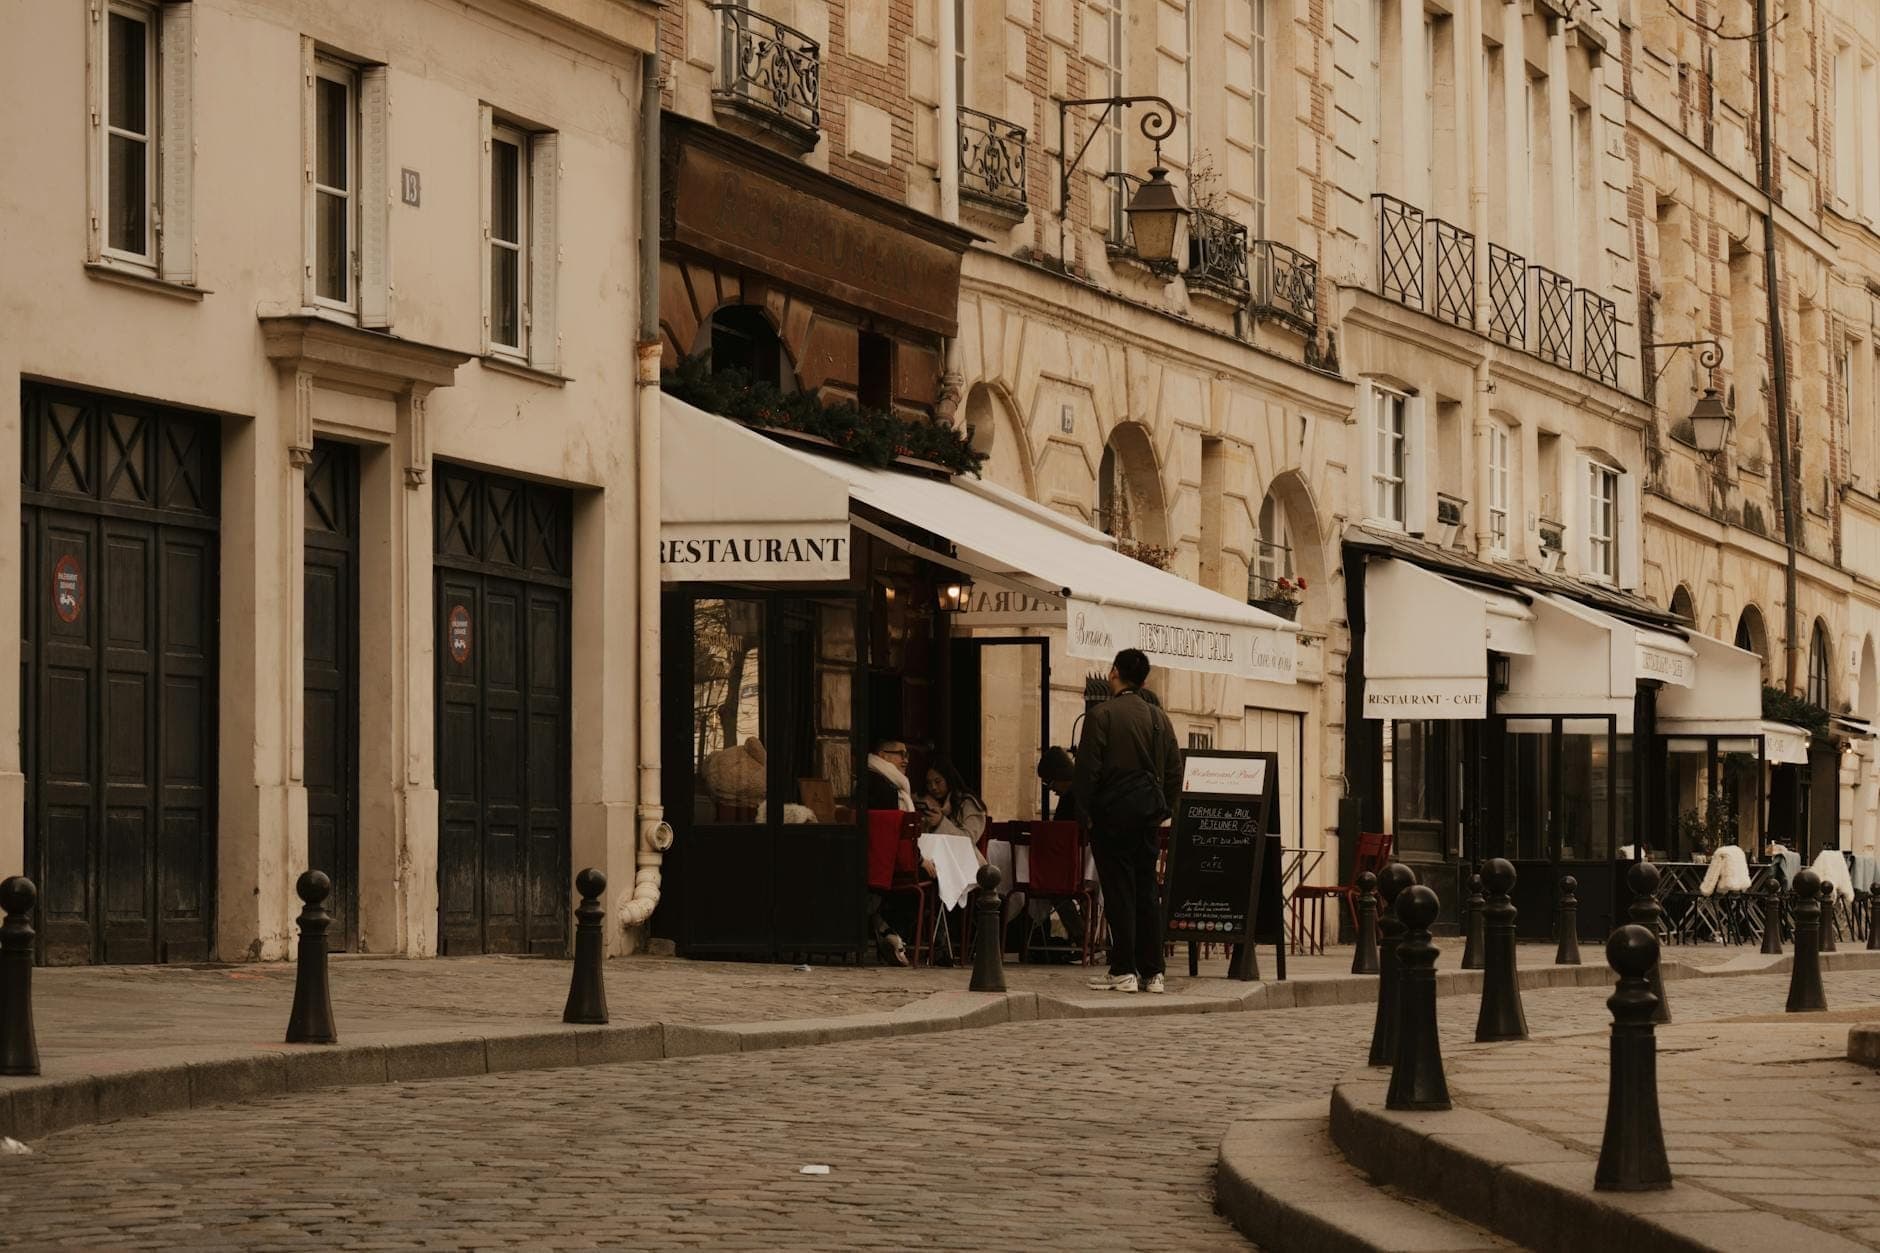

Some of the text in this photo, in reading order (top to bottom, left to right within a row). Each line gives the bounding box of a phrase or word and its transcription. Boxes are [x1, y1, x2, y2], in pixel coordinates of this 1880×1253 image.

[405, 173, 417, 202] 13
[1138, 622, 1234, 662] RESTAURANT PAUL
[1368, 694, 1442, 705] RESTAURANT
[1192, 835, 1218, 845] PLAT
